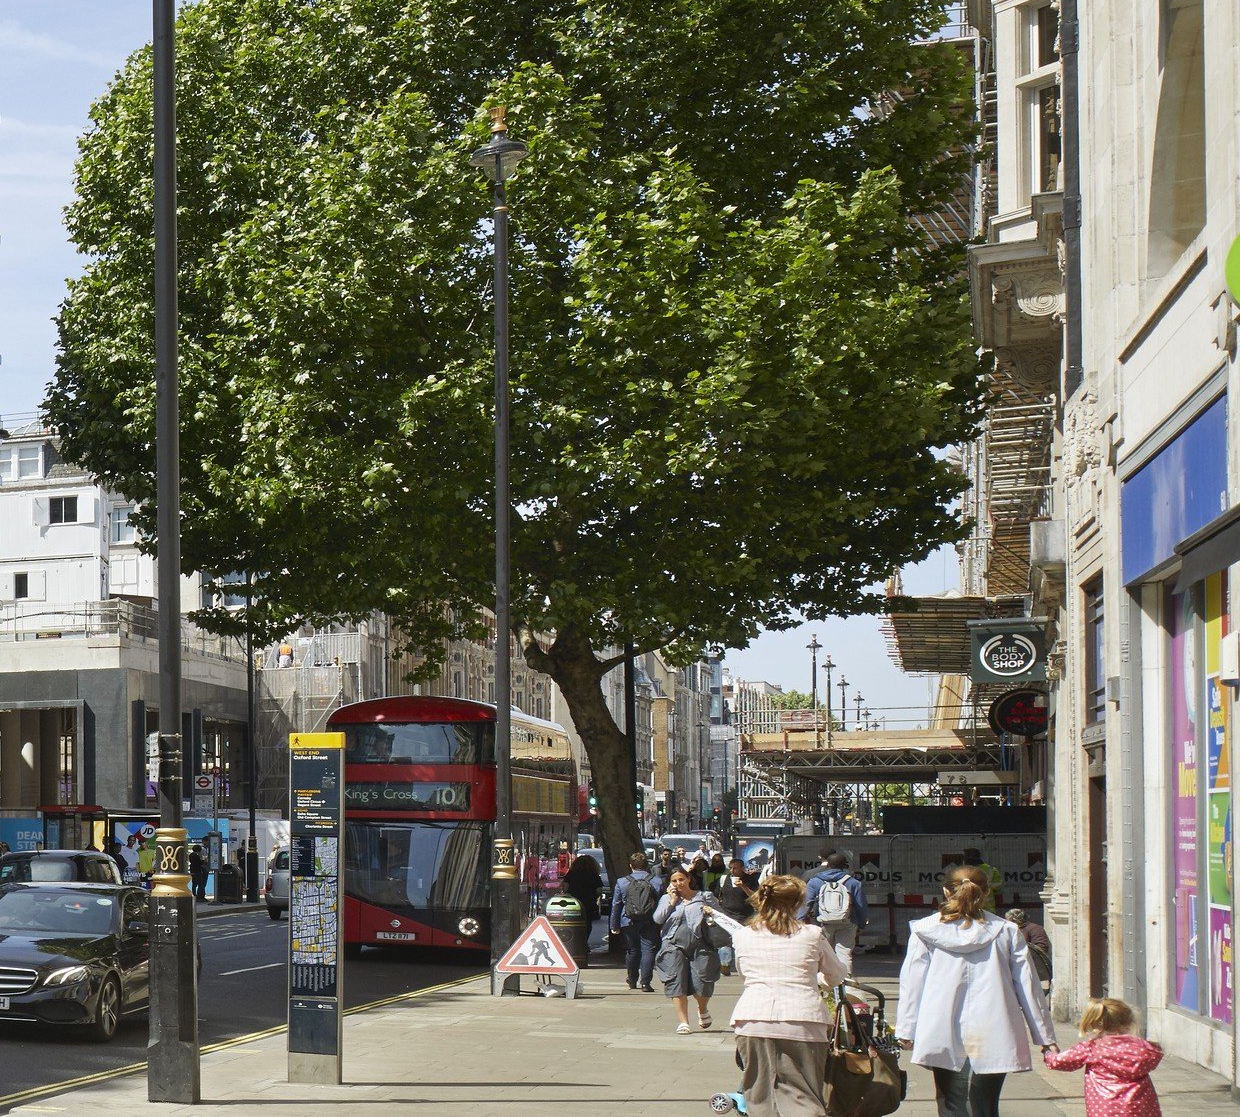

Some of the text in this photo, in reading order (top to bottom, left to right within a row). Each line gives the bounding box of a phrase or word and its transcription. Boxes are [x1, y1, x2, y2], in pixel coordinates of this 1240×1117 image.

[991, 653, 1026, 661] BODY
[993, 660, 1025, 669] SHOP
[344, 788, 418, 802] King's Cross
[435, 787, 456, 804] 10
[17, 831, 44, 840] DEAN
[142, 827, 154, 835] JD
[853, 871, 903, 882] ODUS
[1003, 871, 1045, 882] MOD
